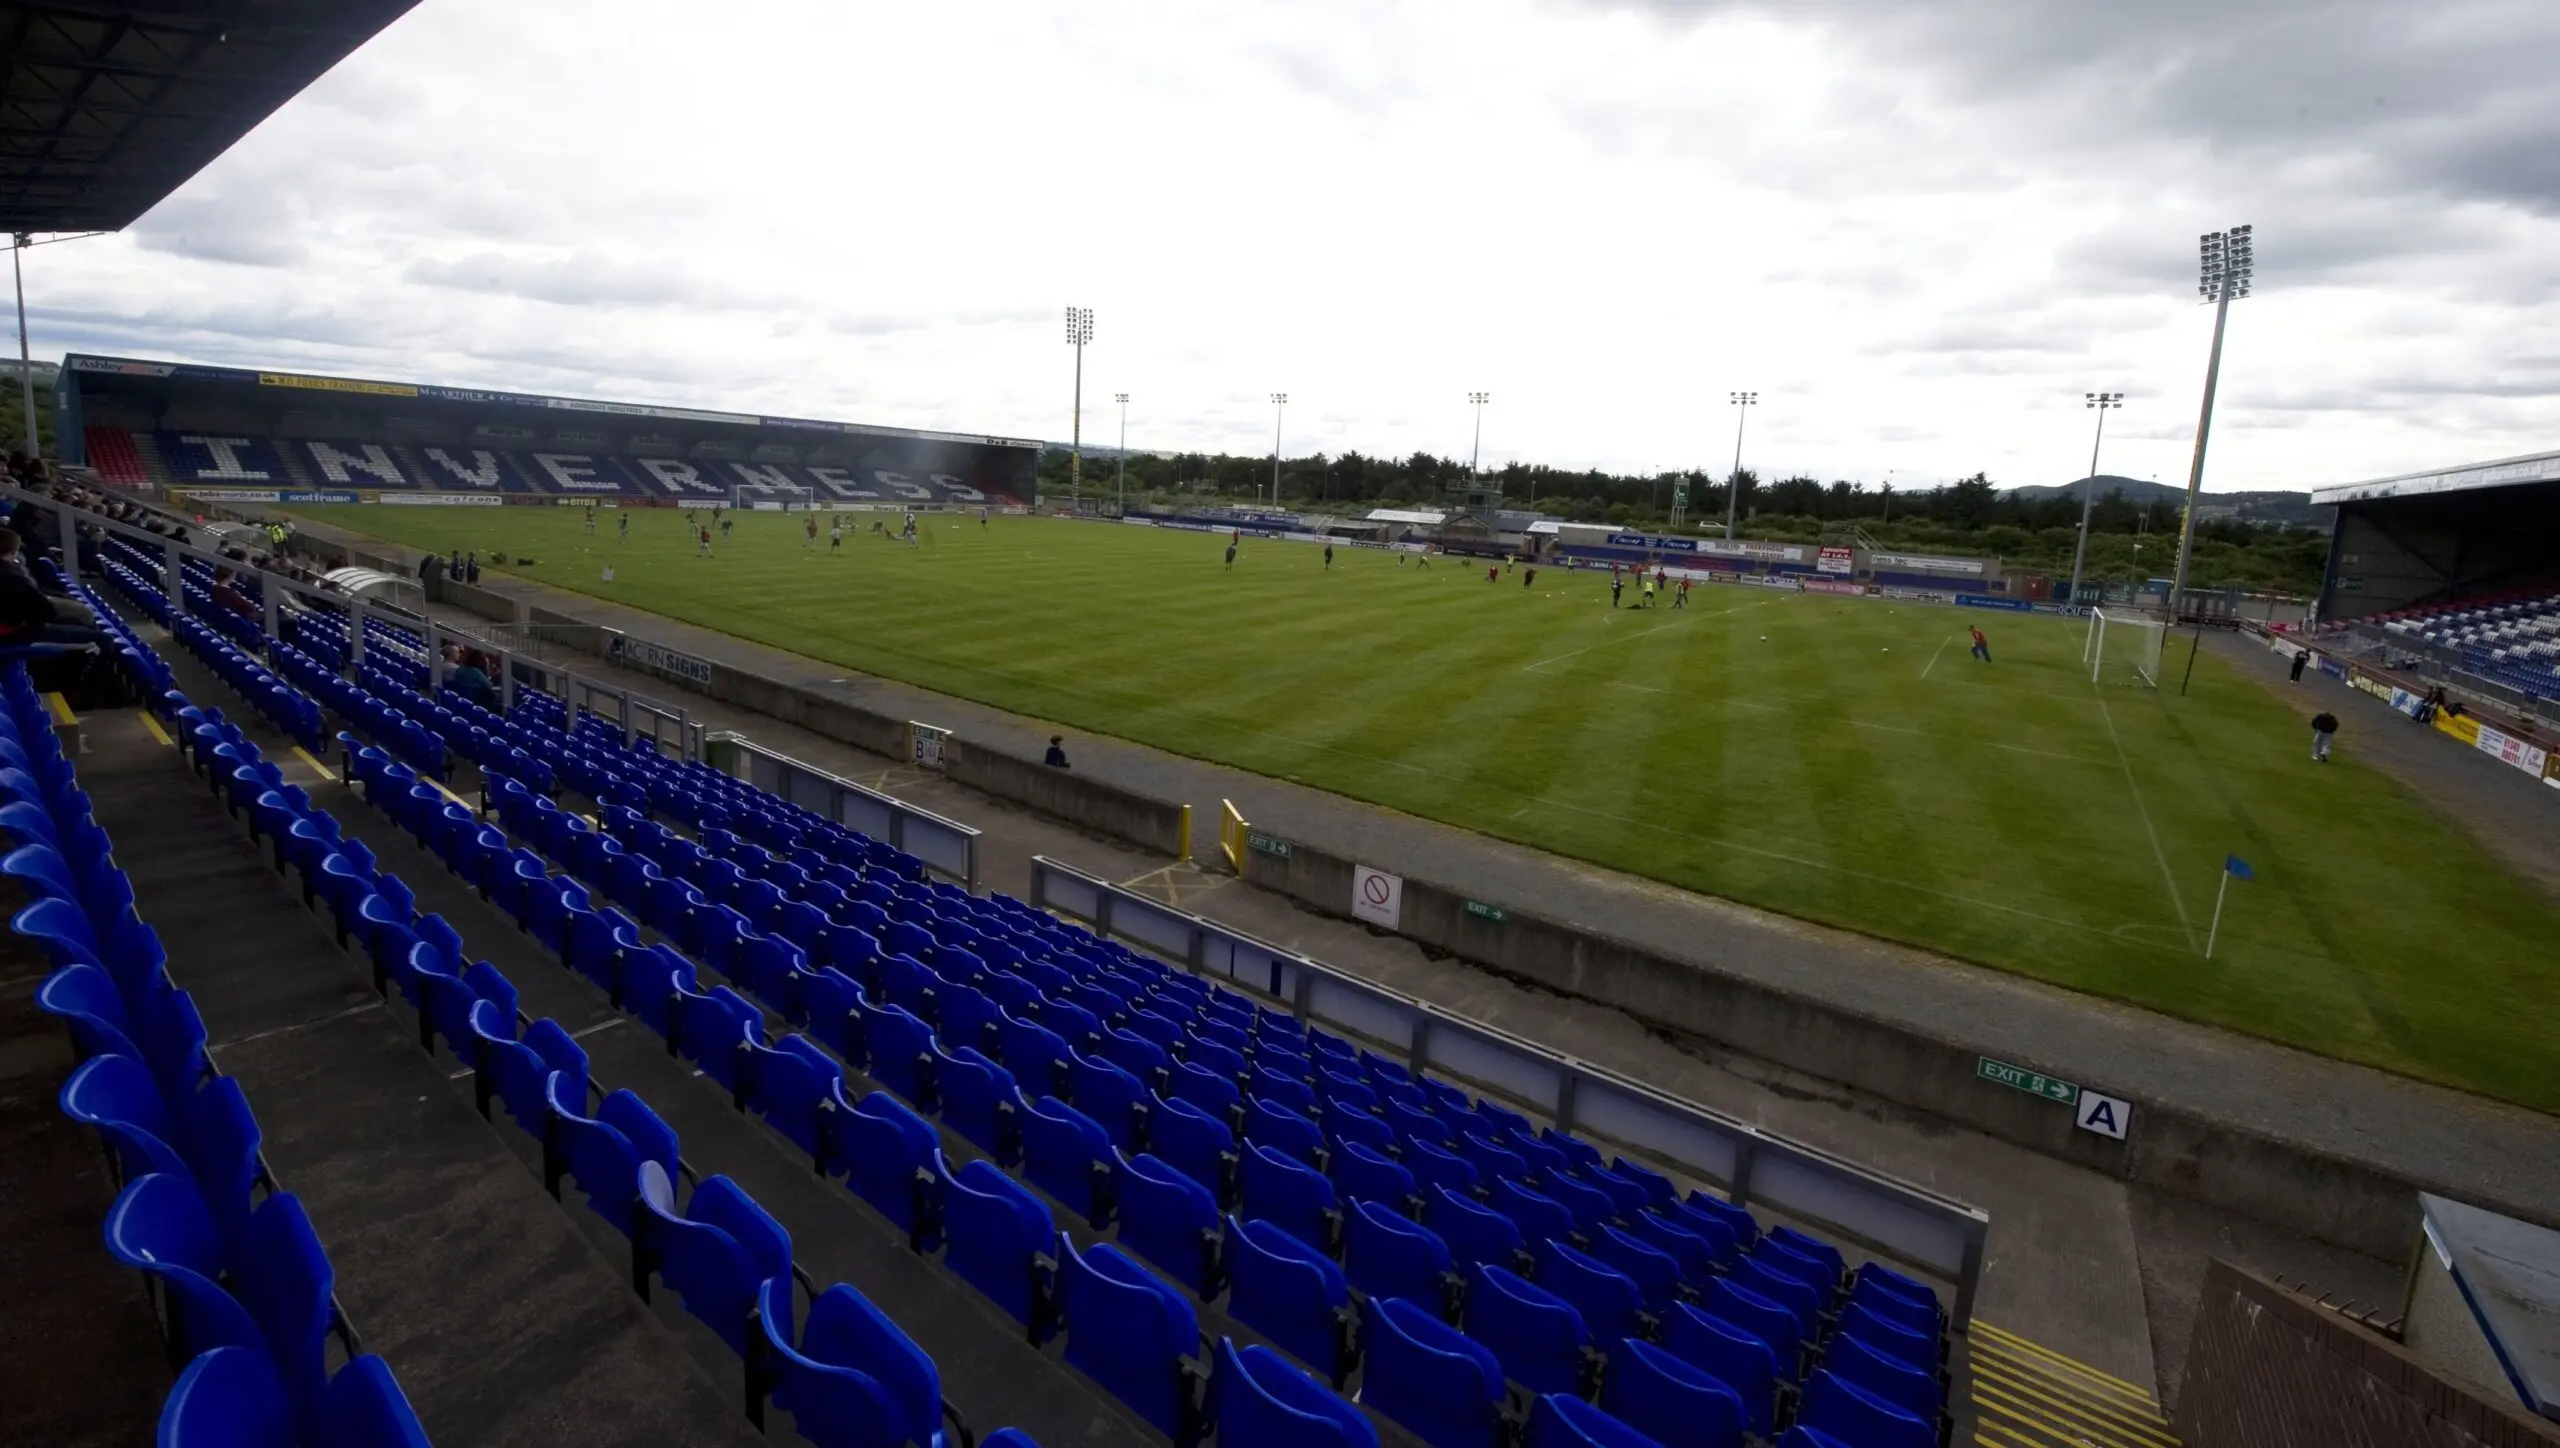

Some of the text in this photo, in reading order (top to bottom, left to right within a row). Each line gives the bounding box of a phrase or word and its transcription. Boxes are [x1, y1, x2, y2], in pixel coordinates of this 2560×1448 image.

[79, 360, 122, 372] Ashley
[180, 435, 985, 500] INVERNESS
[289, 492, 351, 503] scotframe
[2076, 590, 2100, 600] EXIT
[626, 641, 709, 681] ACRN SIGNS
[916, 740, 924, 759] B
[936, 746, 945, 764] A
[1250, 834, 1268, 848] EXIT
[1468, 901, 1488, 915] EXIT
[1985, 1063, 2025, 1084] EXIT
[2085, 1100, 2117, 1133] A
